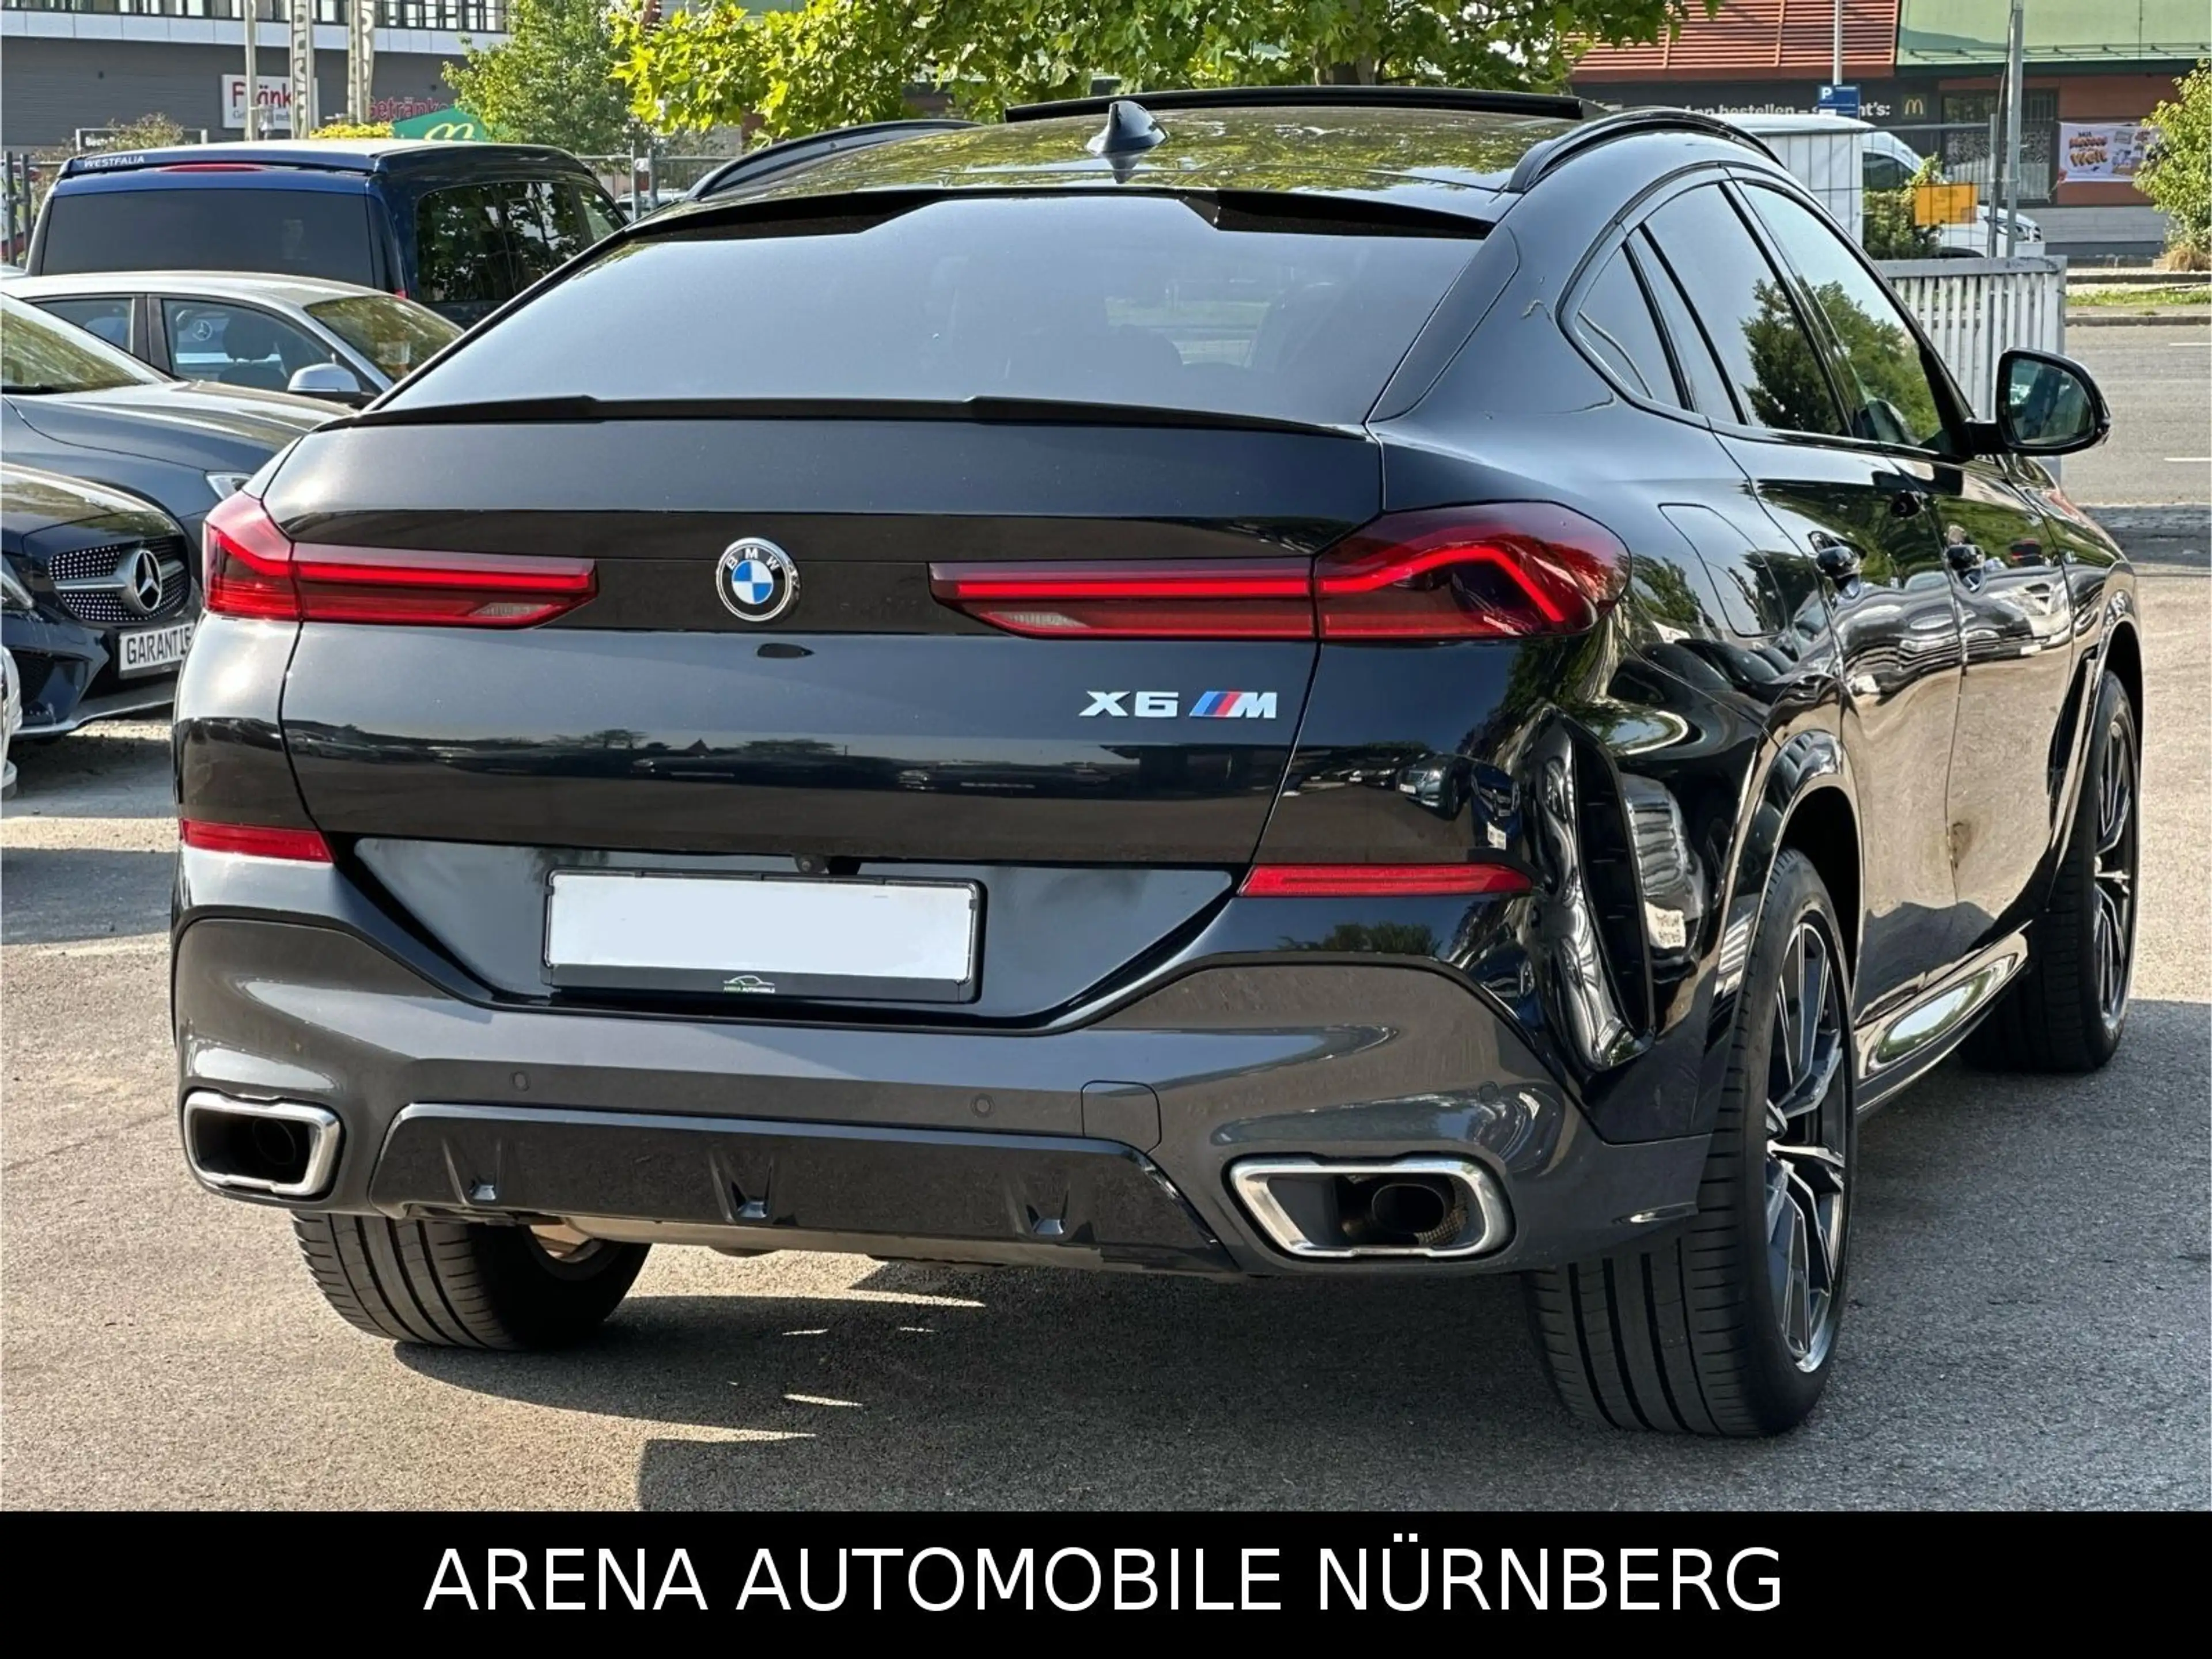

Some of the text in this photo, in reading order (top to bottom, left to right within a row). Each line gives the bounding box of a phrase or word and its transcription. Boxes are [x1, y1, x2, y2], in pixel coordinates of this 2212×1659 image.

[1821, 87, 1833, 100] P
[84, 155, 145, 168] WESTFALIA
[726, 547, 781, 571] BMW
[1078, 691, 1179, 717] X6
